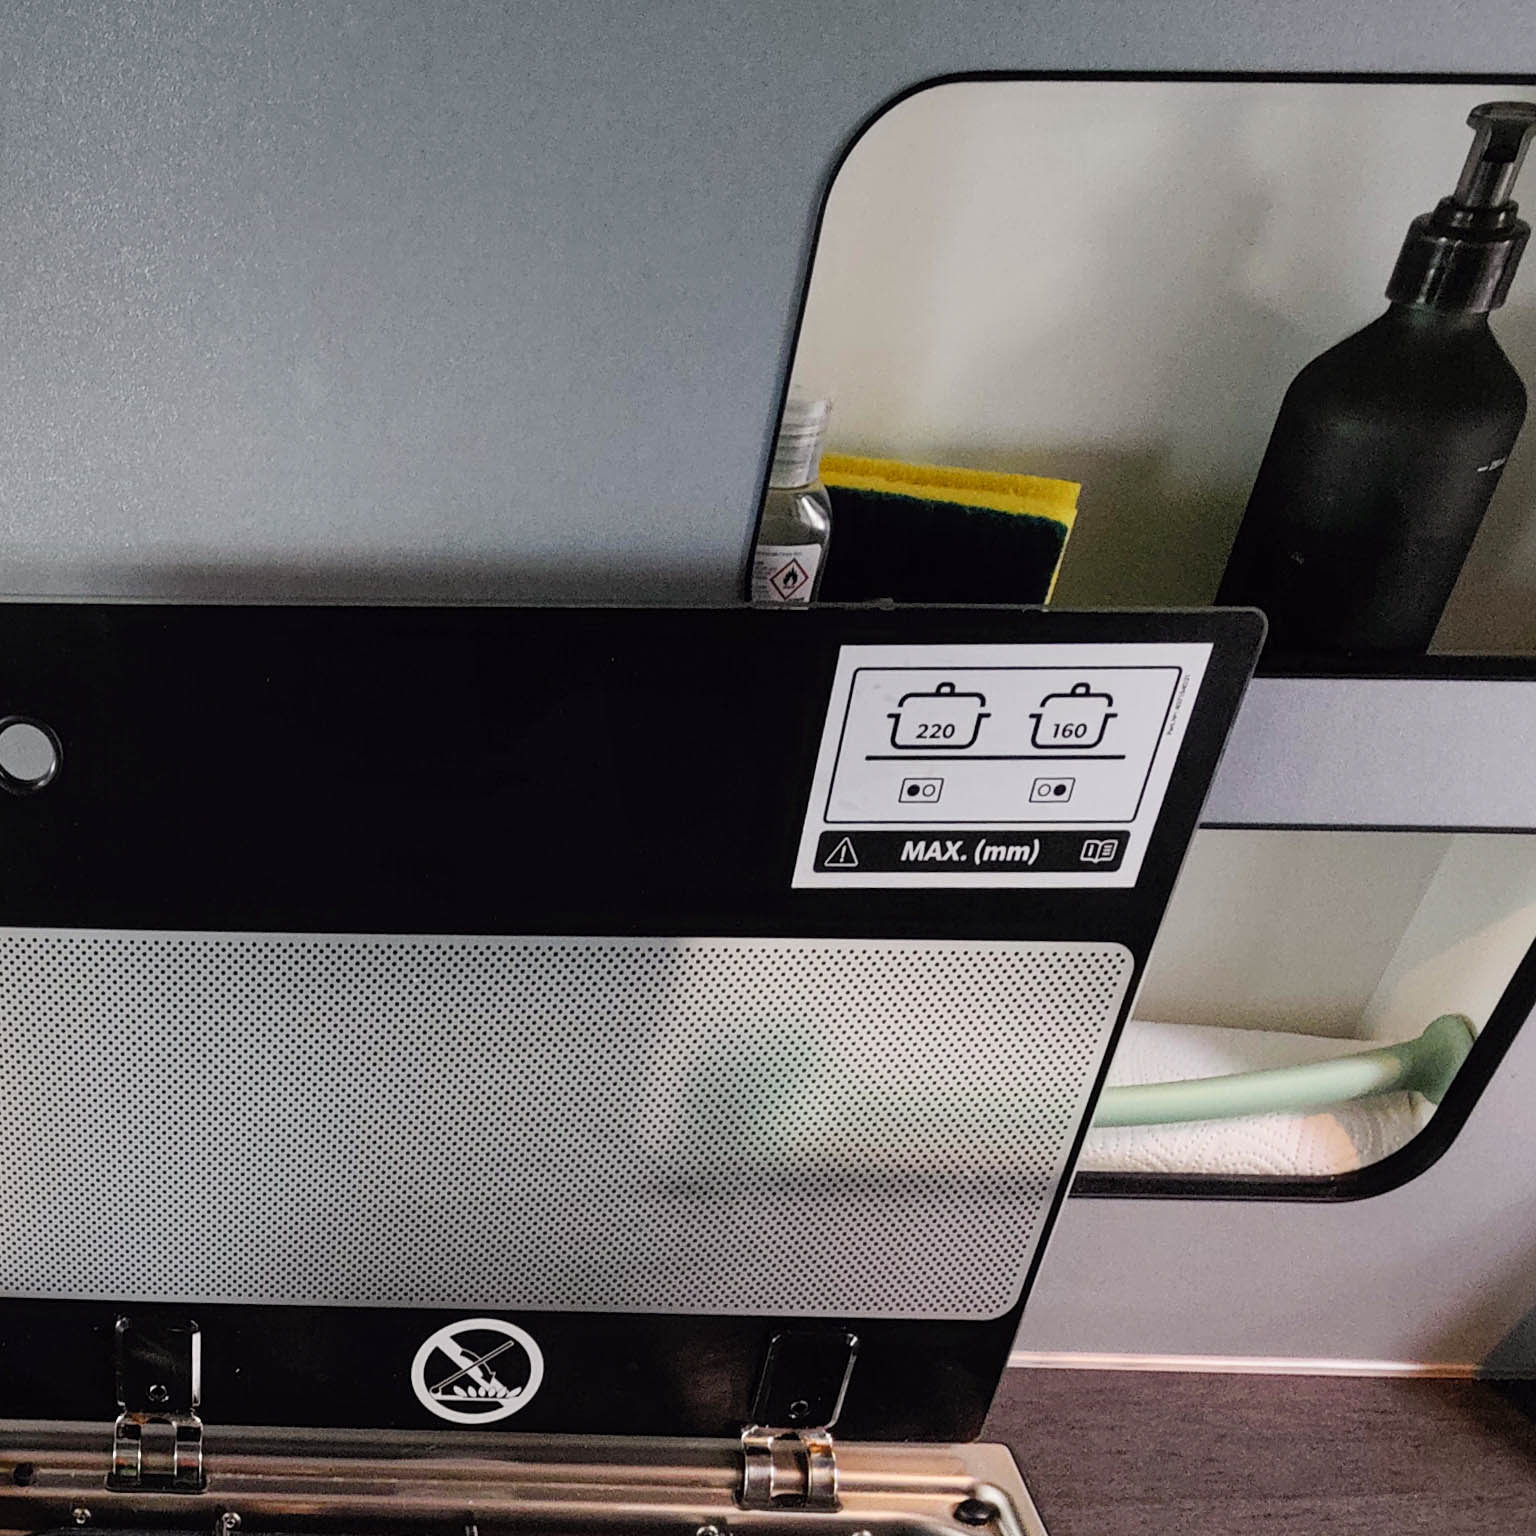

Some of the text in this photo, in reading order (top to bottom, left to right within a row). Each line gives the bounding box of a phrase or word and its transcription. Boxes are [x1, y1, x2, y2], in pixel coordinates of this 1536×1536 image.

[915, 723, 956, 740] 220
[1052, 722, 1088, 739] 160
[900, 838, 1040, 866] MAX. (mm)
